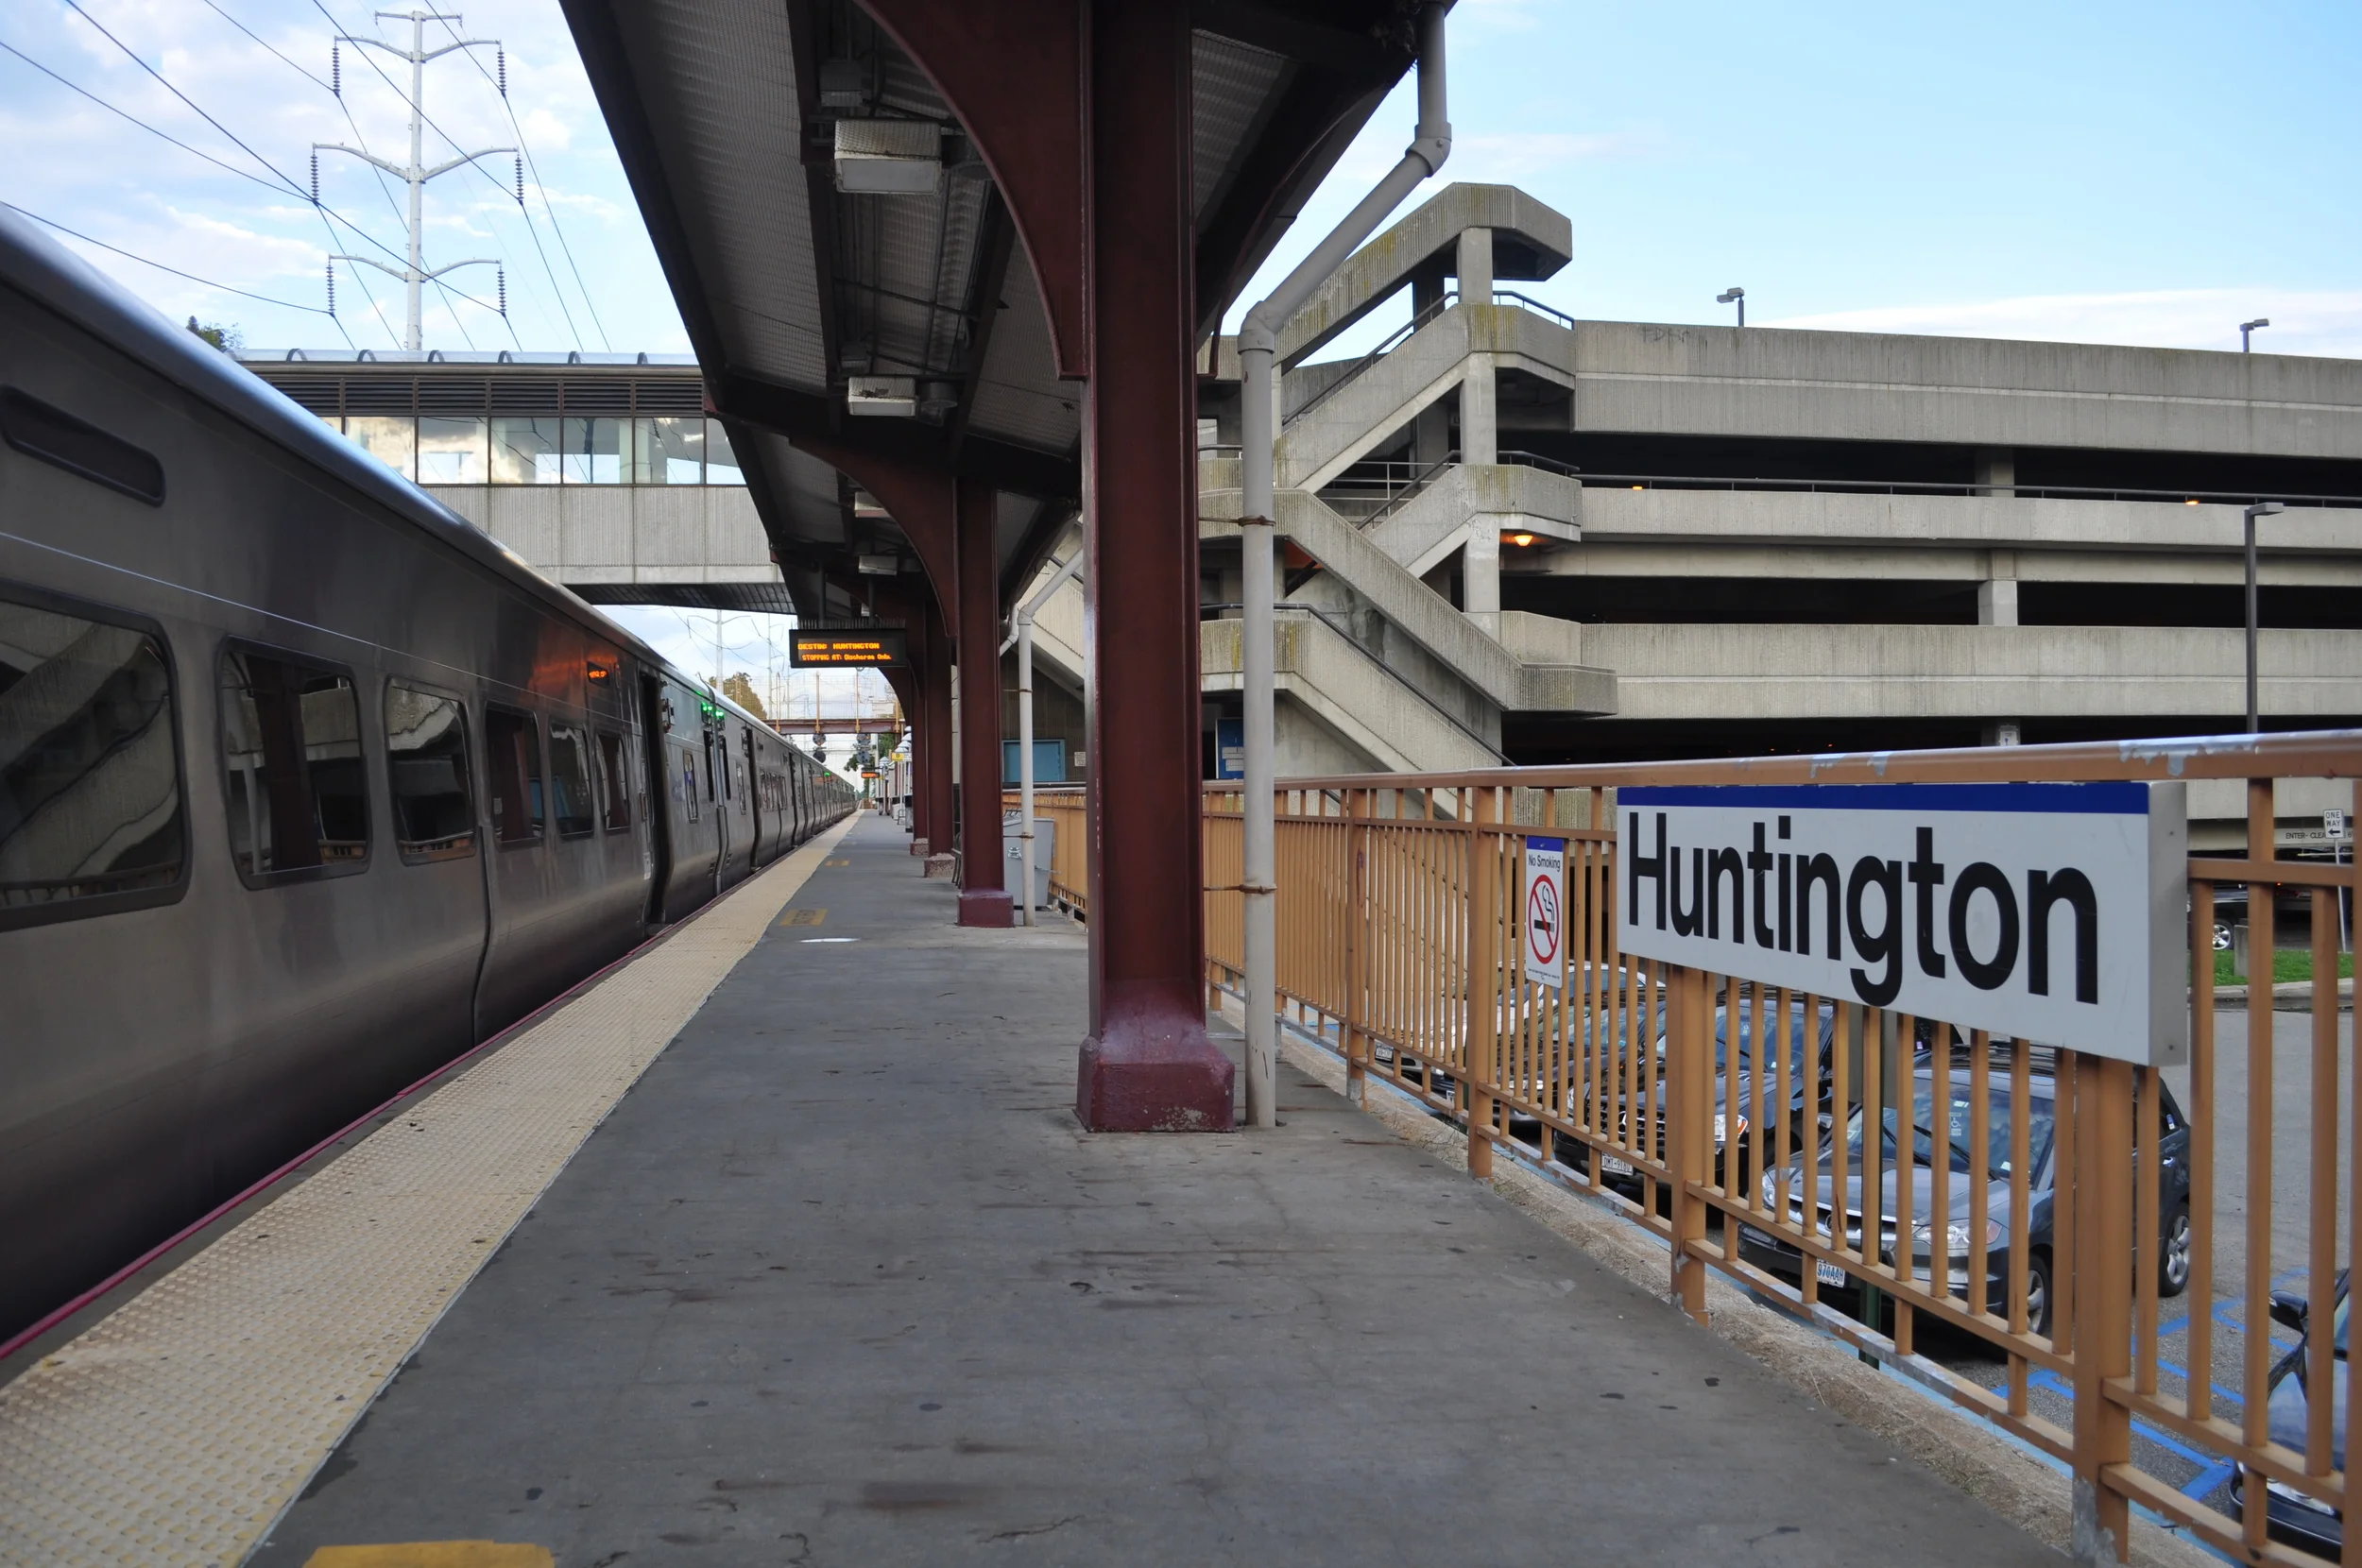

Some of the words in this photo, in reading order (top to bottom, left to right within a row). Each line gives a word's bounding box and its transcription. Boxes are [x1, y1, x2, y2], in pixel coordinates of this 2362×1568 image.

[1528, 854, 1536, 866] No
[1537, 855, 1560, 872] Smoking
[1629, 811, 2098, 1007] Huntington
